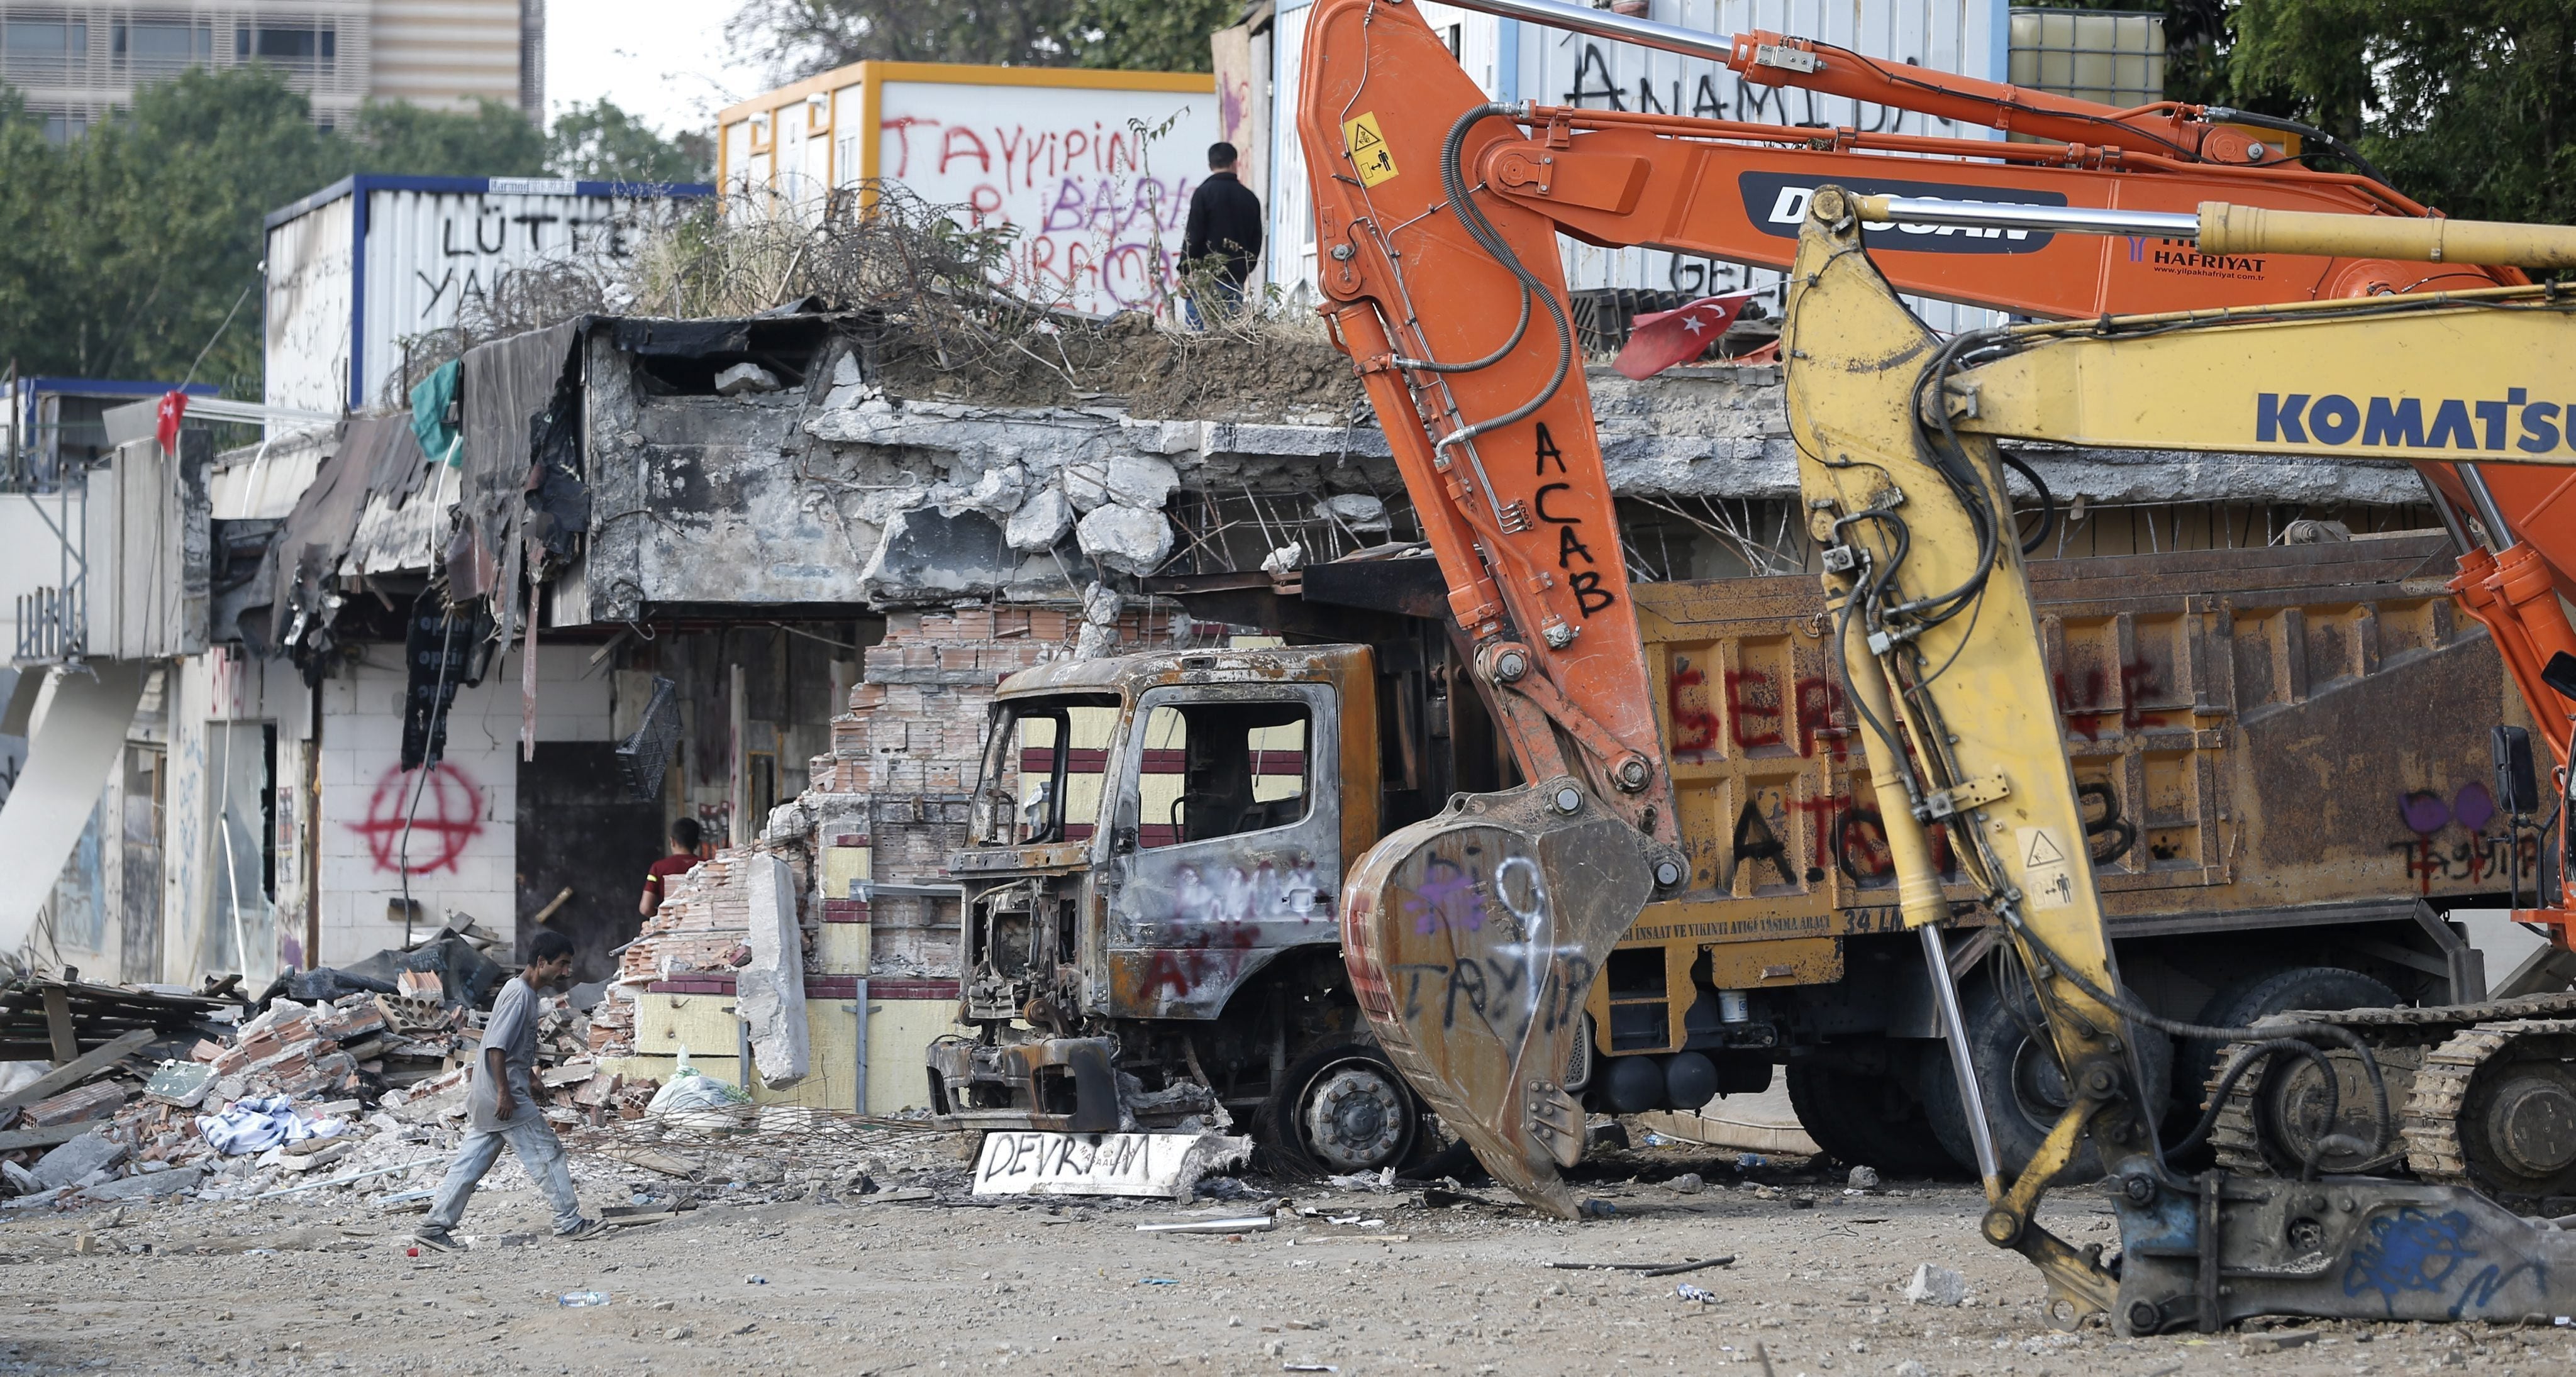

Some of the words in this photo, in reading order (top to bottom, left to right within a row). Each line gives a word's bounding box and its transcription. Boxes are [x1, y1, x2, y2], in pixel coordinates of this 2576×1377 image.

[2155, 250, 2266, 272] HAFRIYAT
[2256, 387, 2576, 453] KOMATS
[1674, 924, 1687, 937] VE
